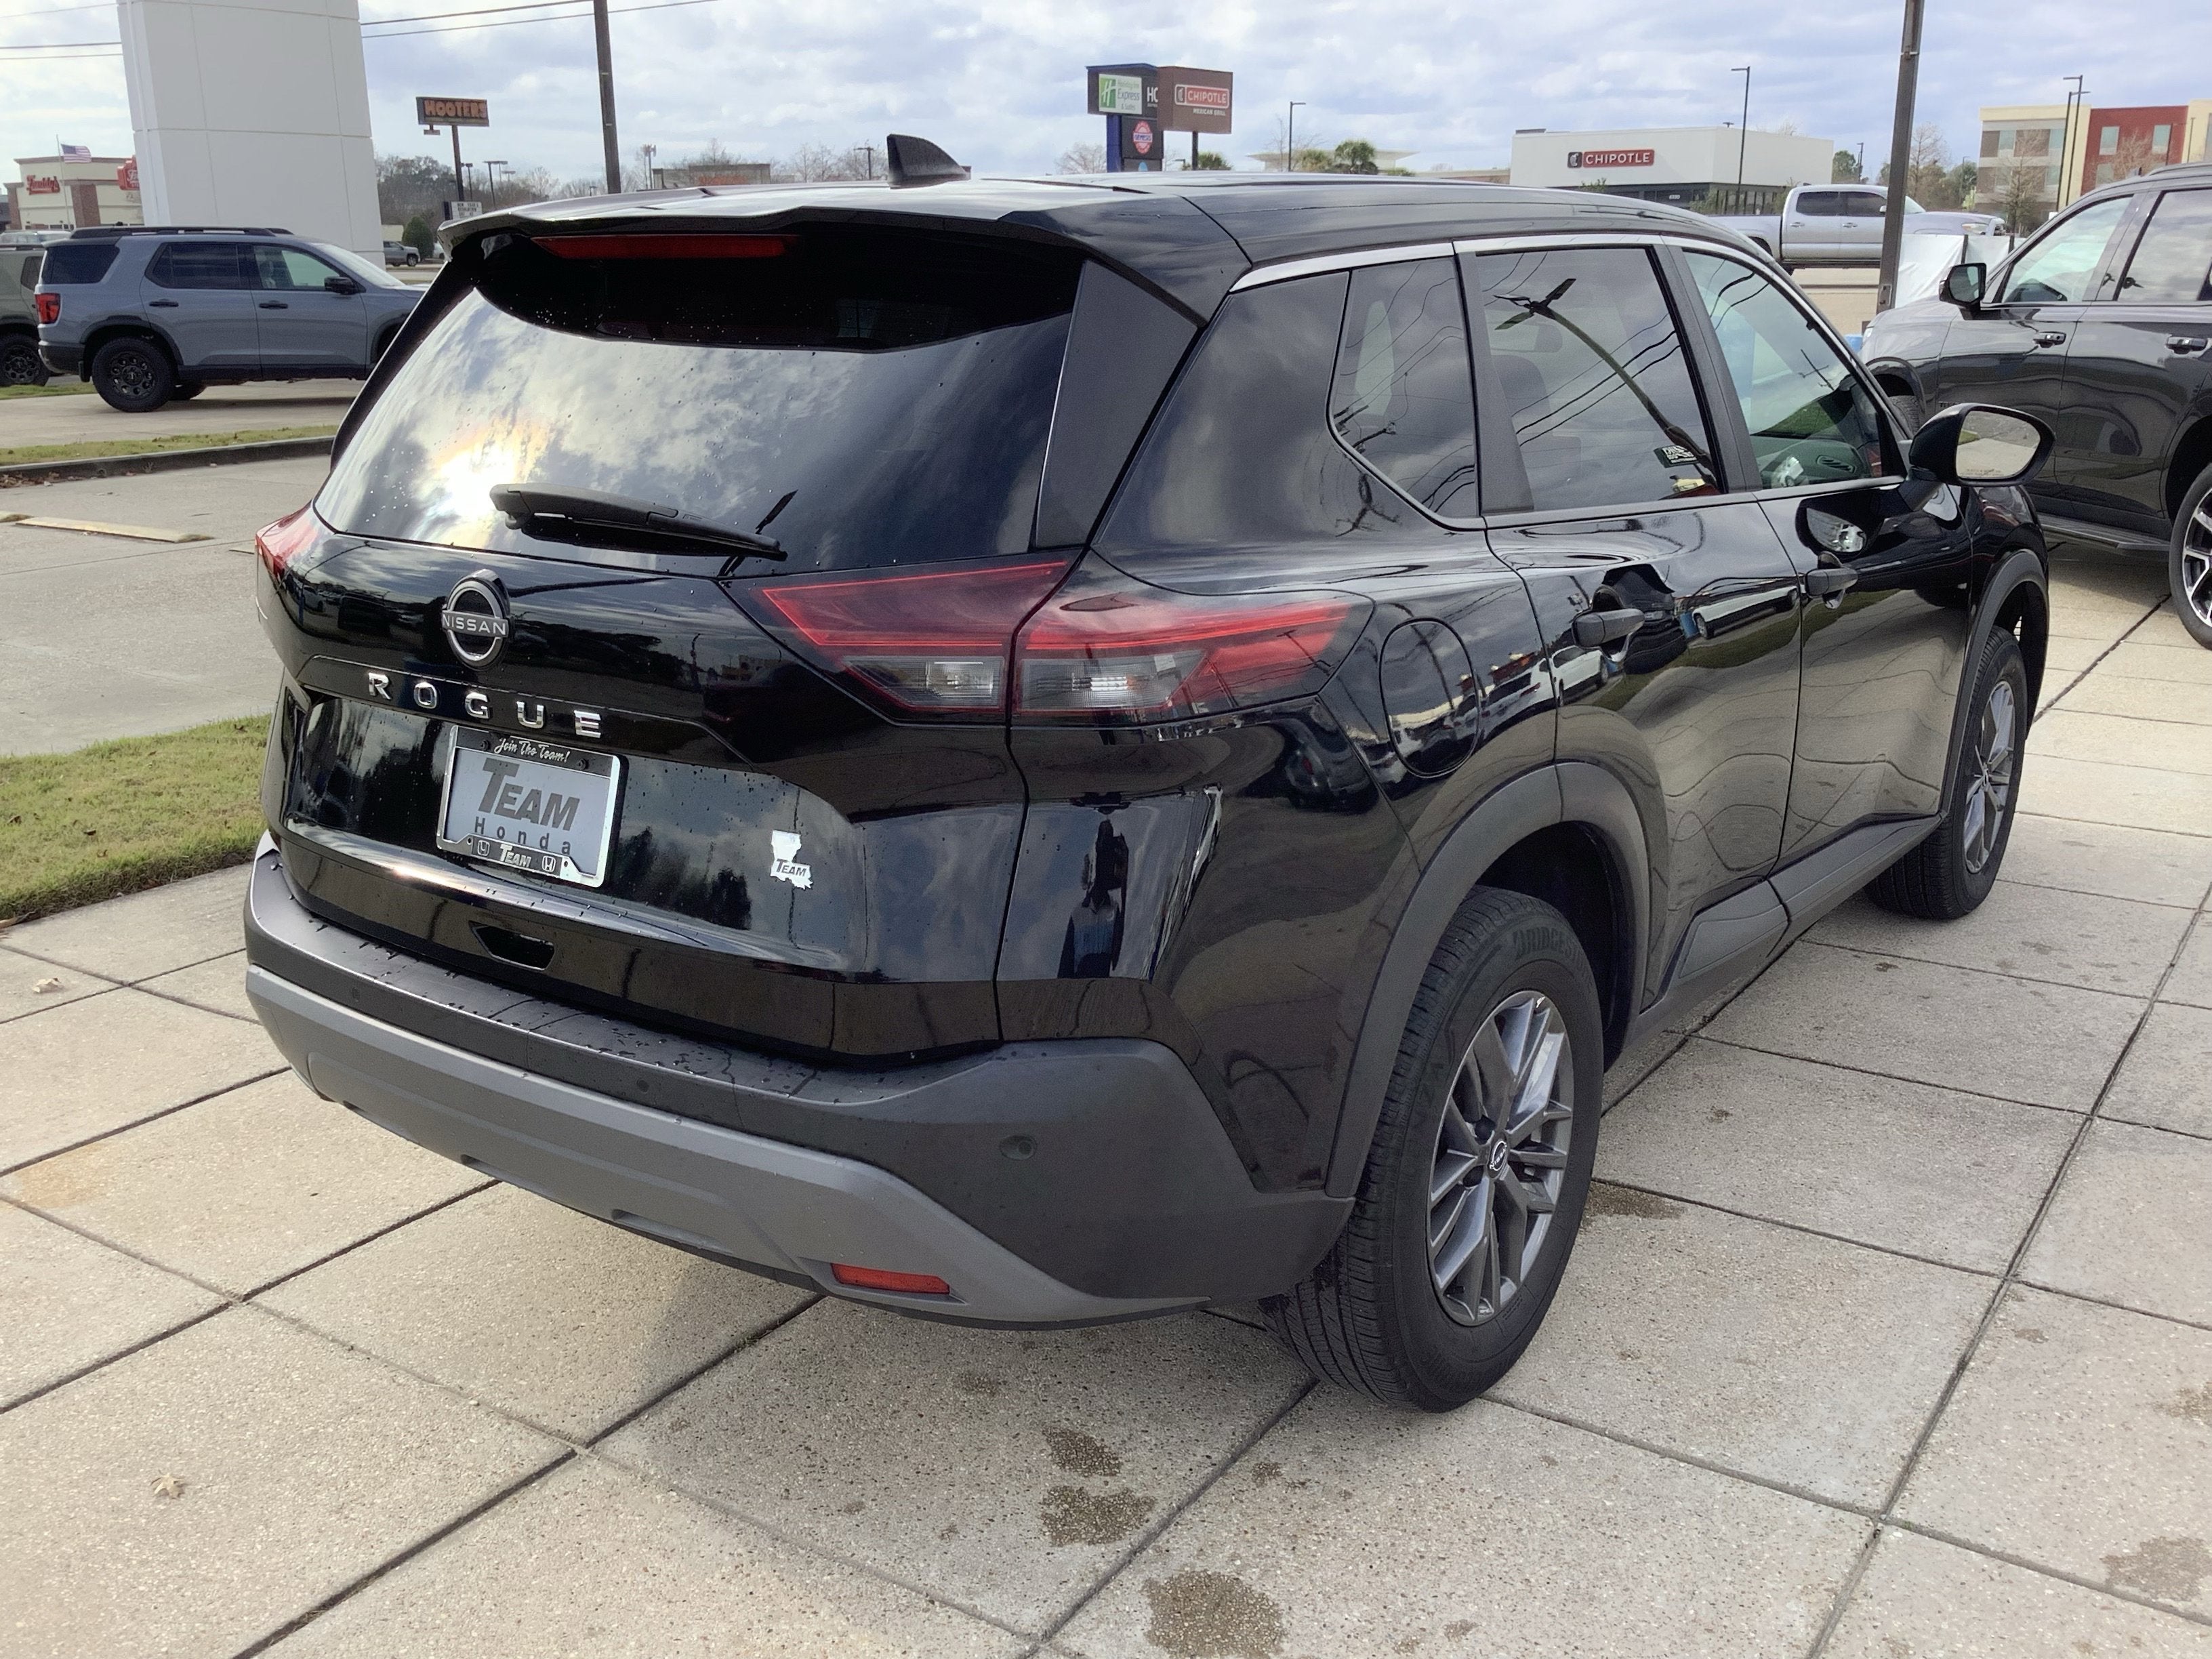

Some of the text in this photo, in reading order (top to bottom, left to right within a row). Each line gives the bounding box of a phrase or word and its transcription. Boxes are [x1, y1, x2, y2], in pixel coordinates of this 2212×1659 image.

[1187, 90, 1227, 104] CHIPOTLE
[1585, 152, 1651, 165] CHIPOTLE
[443, 613, 506, 636] NISSAN
[368, 672, 602, 739] ROGUE
[493, 738, 571, 763] Join The Team!
[474, 816, 571, 855] Honda
